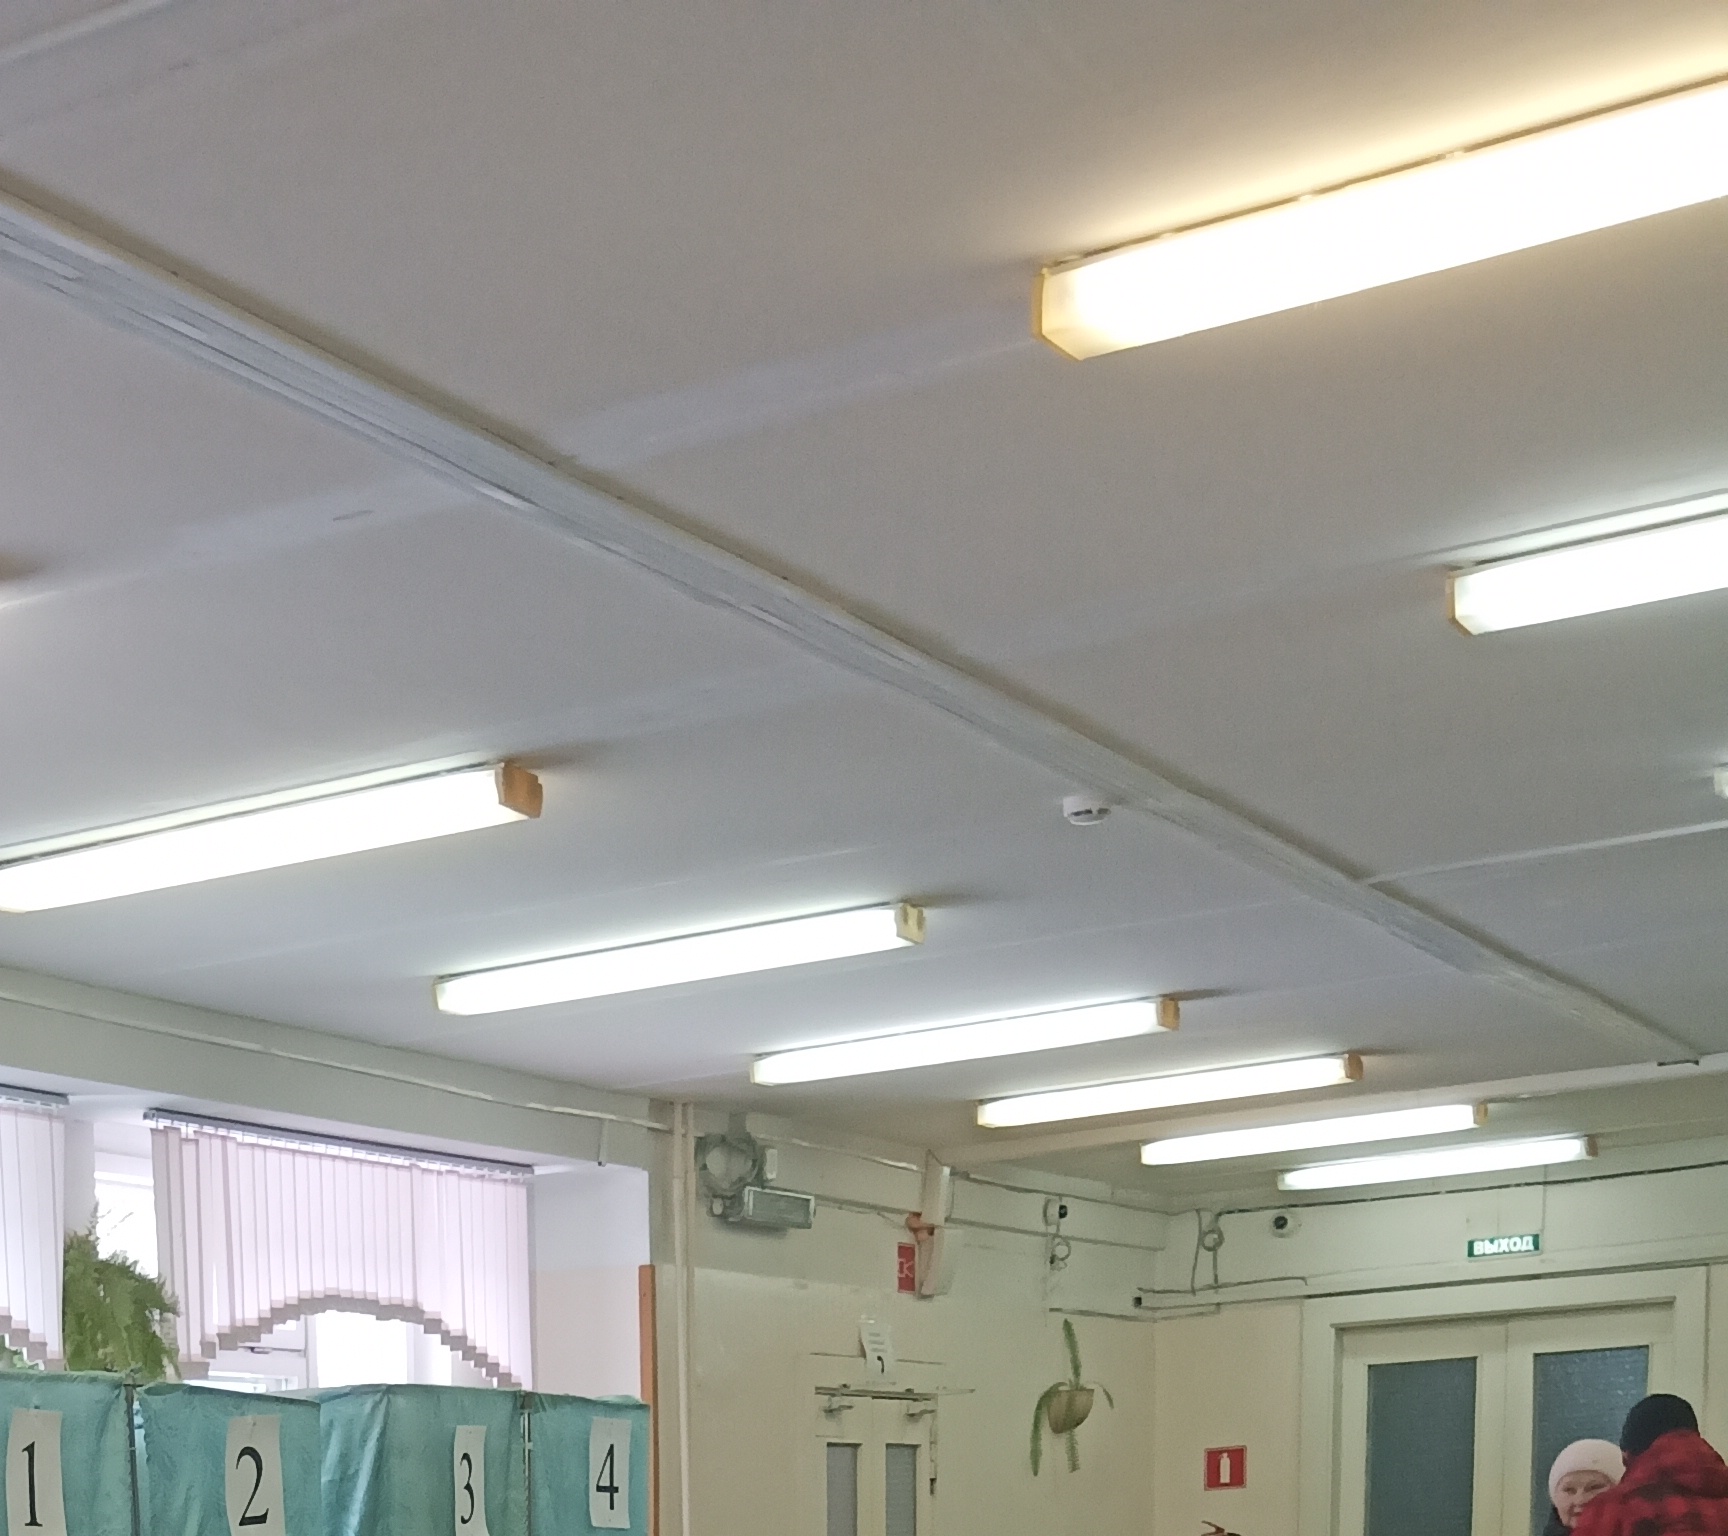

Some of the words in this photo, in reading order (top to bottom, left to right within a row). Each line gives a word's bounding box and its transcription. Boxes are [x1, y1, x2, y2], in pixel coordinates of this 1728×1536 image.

[1473, 1235, 1534, 1256] ВЫХОД
[22, 1440, 44, 1528] 1
[234, 1445, 270, 1528] 2
[459, 1451, 476, 1526] 3
[594, 1442, 620, 1512] 4
